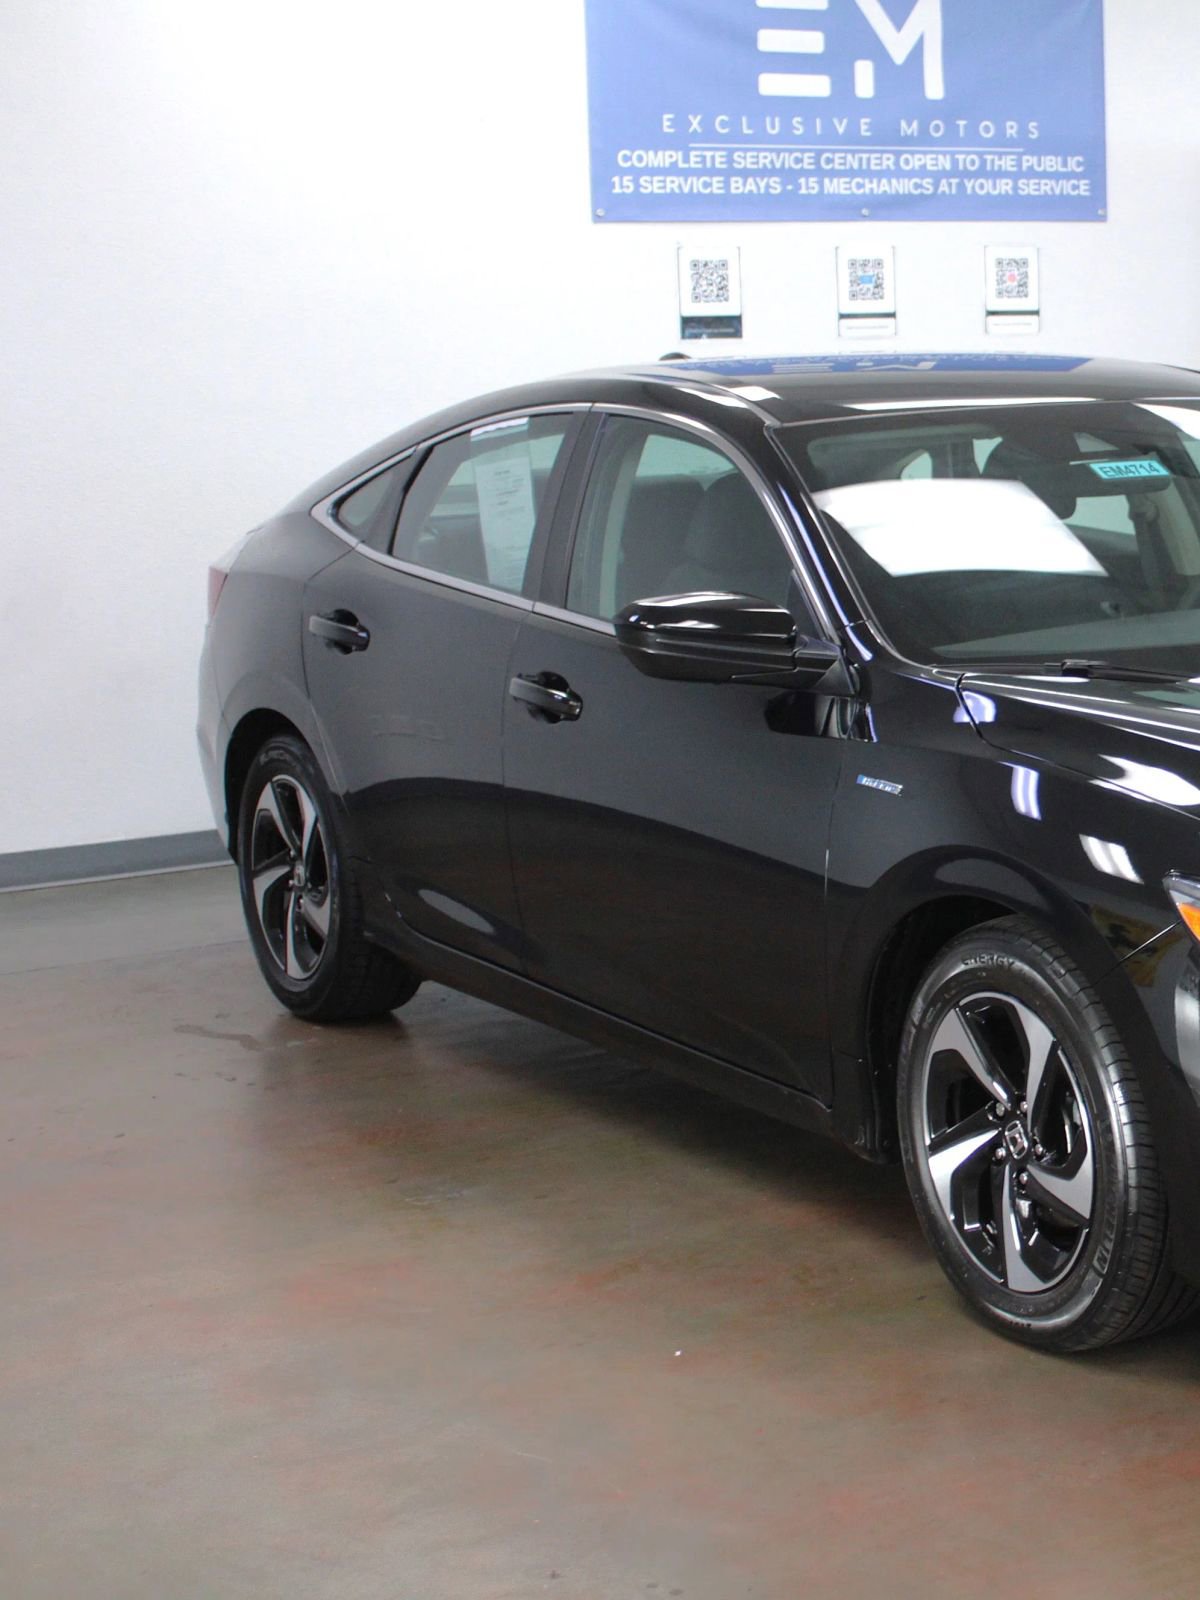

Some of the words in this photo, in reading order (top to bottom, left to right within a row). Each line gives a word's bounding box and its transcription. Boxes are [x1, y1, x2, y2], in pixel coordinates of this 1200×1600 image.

[662, 113, 873, 137] EXCLUSIVE
[899, 119, 1041, 139] MOTORS
[616, 149, 728, 169] COMPLETE
[732, 151, 816, 170] SERVICE
[819, 152, 895, 171] CENTER
[899, 153, 951, 171] OPEN
[954, 154, 980, 171] TO
[983, 155, 1018, 172] THE
[1021, 155, 1085, 173] PUBLIC
[611, 175, 635, 194] 15
[638, 176, 725, 194] SERVICE
[730, 177, 782, 195] BAYS
[798, 177, 819, 195] 15
[823, 178, 934, 196] MECHANICS
[937, 179, 960, 196] AT
[964, 179, 1013, 196] YOUR
[1017, 179, 1091, 197] SERVICE
[1098, 463, 1161, 478] EM4714
